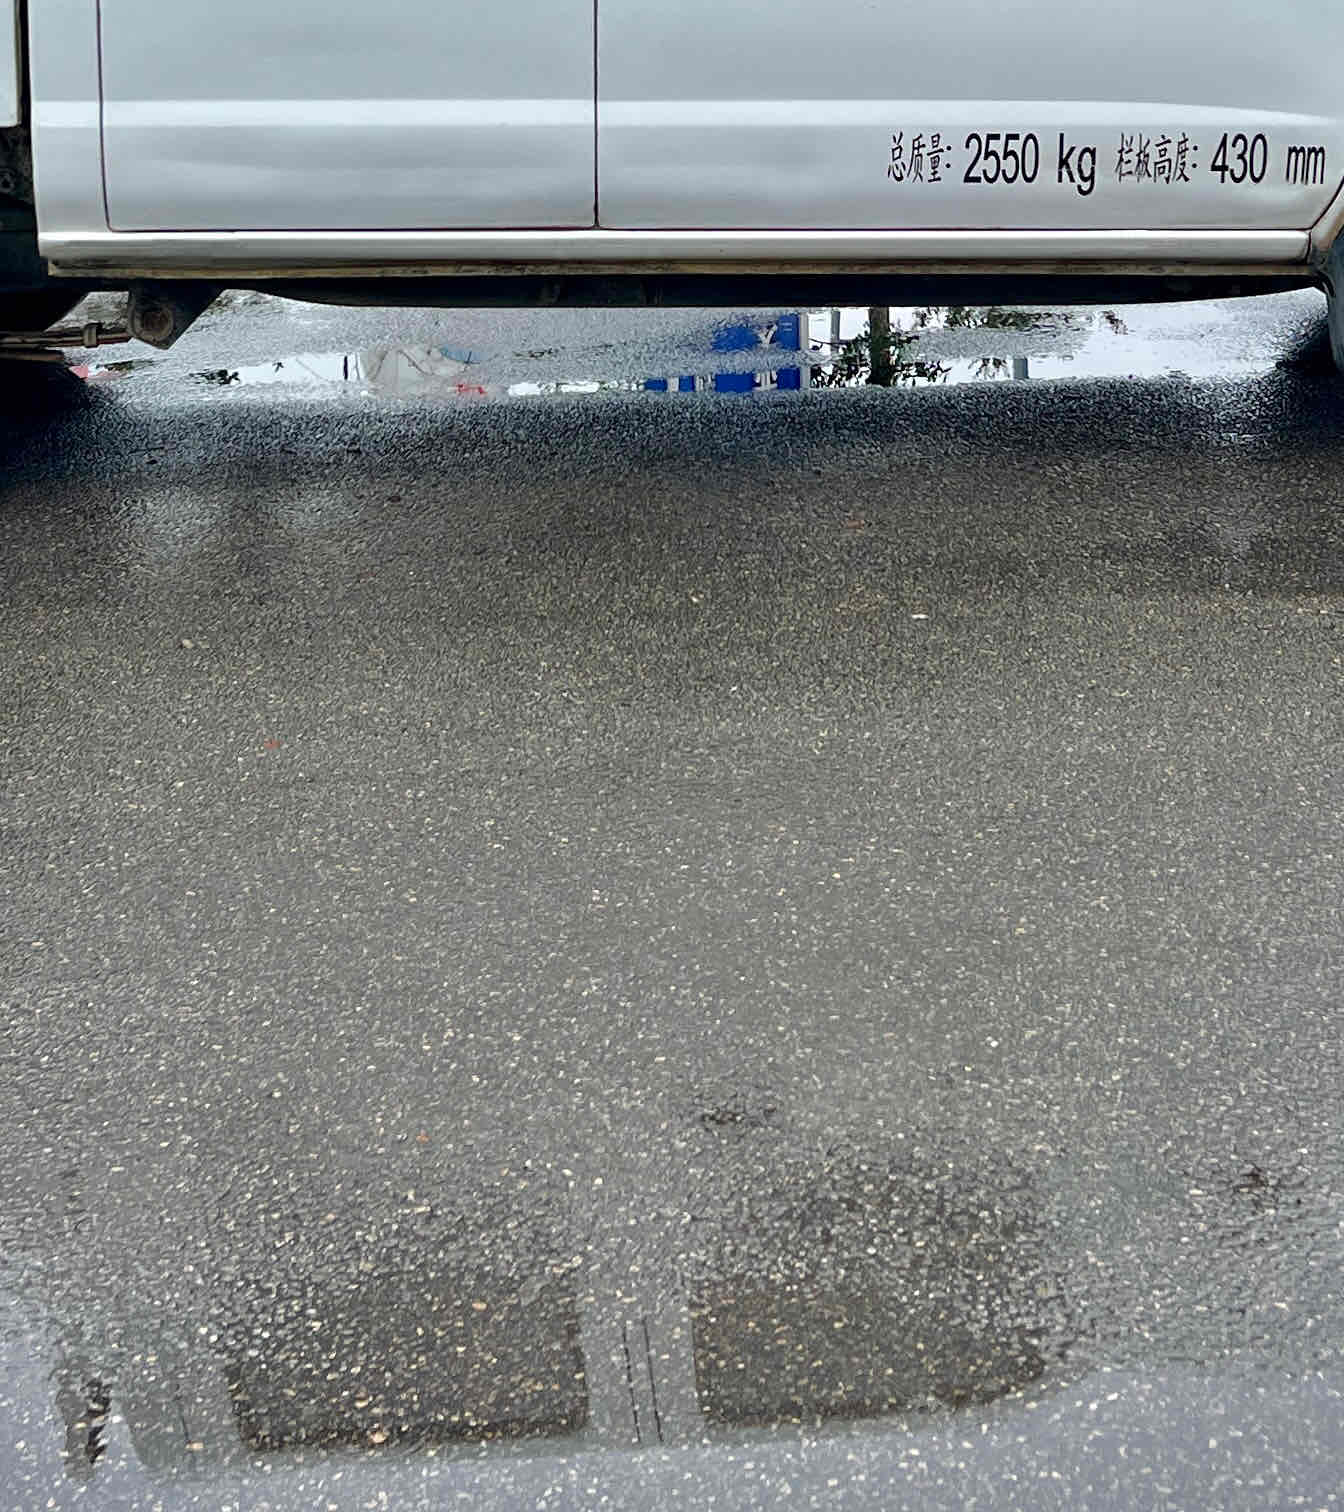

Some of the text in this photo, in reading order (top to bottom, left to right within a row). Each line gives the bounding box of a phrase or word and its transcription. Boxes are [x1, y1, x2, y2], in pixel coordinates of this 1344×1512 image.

[887, 131, 1326, 197] 总质量: 2550 kg 栏板高度: 430 mm
